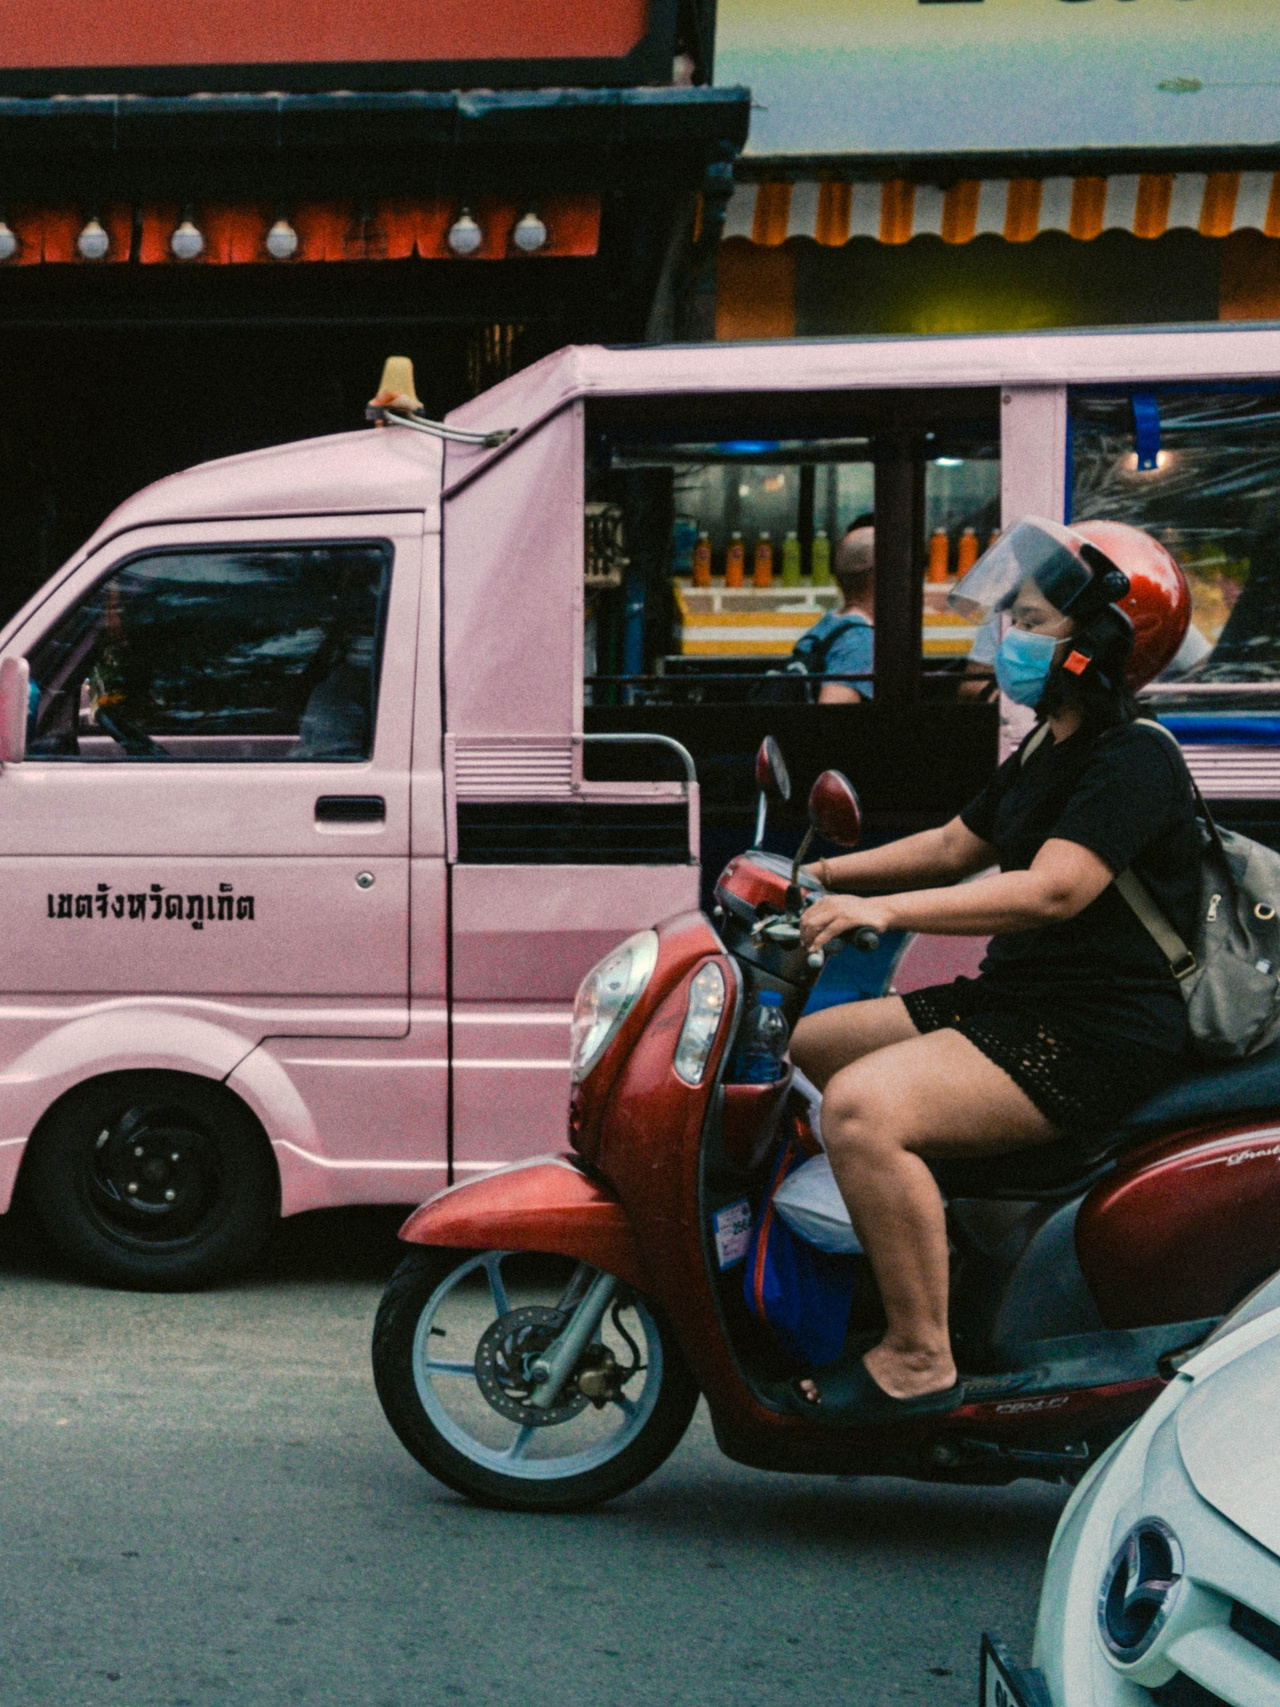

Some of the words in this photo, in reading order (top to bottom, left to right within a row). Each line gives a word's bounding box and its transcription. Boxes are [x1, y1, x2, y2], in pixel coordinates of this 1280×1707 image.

[46, 882, 256, 931] เขตจังหวัดภูเก็ต
